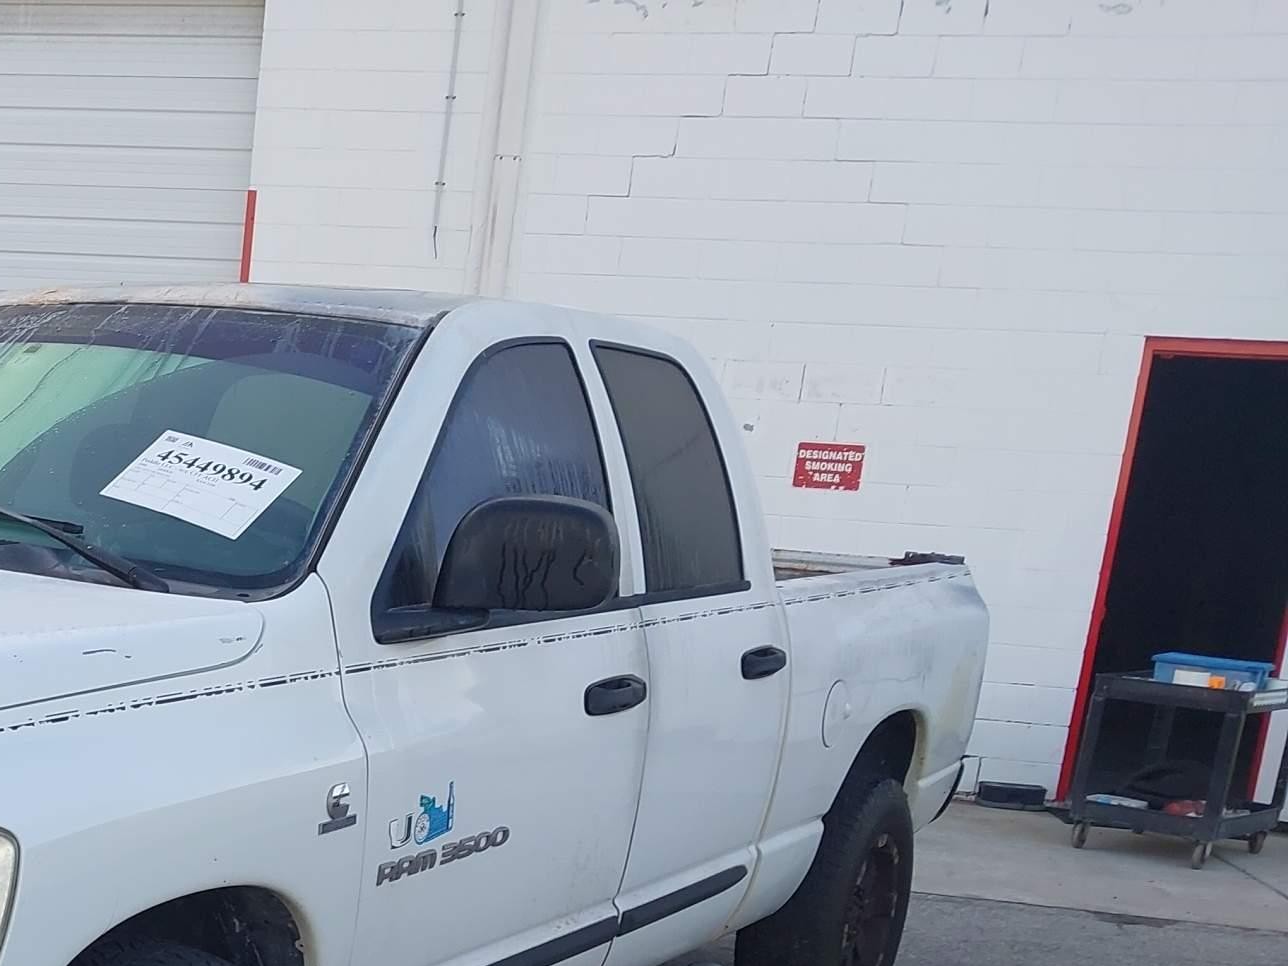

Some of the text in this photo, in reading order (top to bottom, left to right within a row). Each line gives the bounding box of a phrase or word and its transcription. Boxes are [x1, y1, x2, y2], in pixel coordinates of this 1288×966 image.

[798, 449, 862, 461] DESIGNATED
[156, 450, 268, 491] 45449894
[804, 460, 852, 472] SMOKING
[812, 472, 840, 483] AREA
[376, 826, 510, 887] RAM 3500
